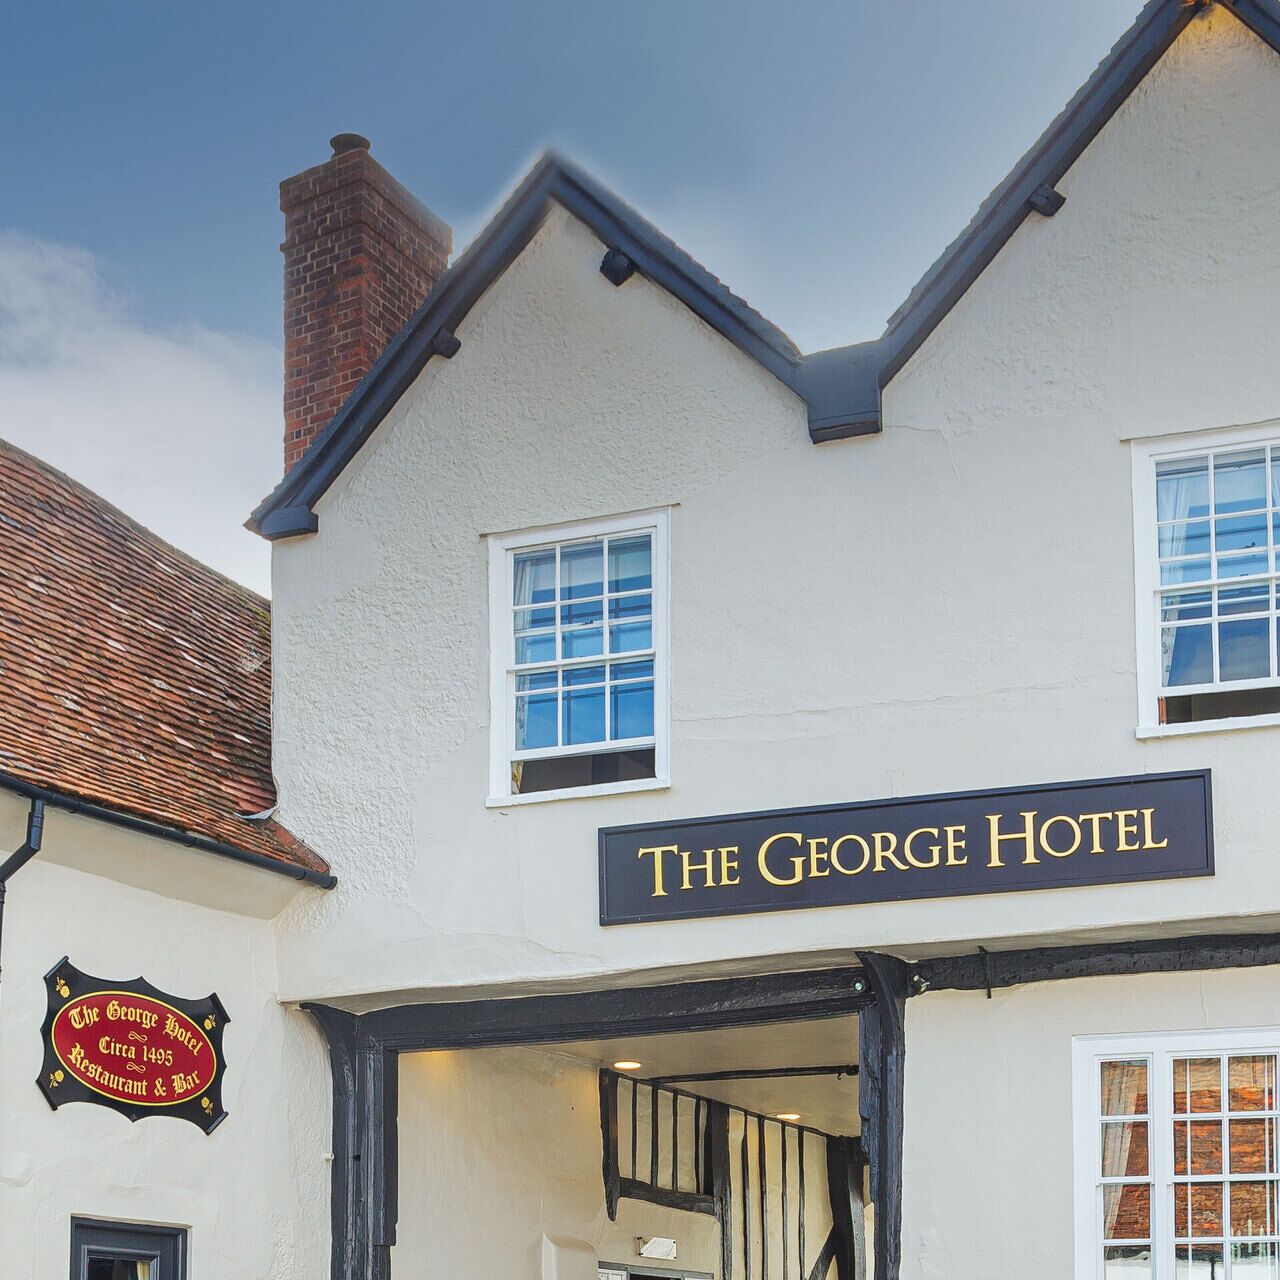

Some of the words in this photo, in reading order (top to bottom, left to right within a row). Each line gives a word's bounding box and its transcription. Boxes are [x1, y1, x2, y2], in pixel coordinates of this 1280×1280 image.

[638, 843, 740, 897] THE
[757, 825, 968, 886] GEORGE
[986, 807, 1168, 868] HOTEL
[68, 1004, 100, 1030] The
[106, 1000, 159, 1029] George
[163, 1013, 204, 1056] Hotel
[98, 1036, 136, 1060] Circa
[142, 1045, 174, 1067] 1495
[67, 1043, 148, 1096] Restaurant
[154, 1077, 167, 1097] &
[171, 1070, 201, 1098] Bar
